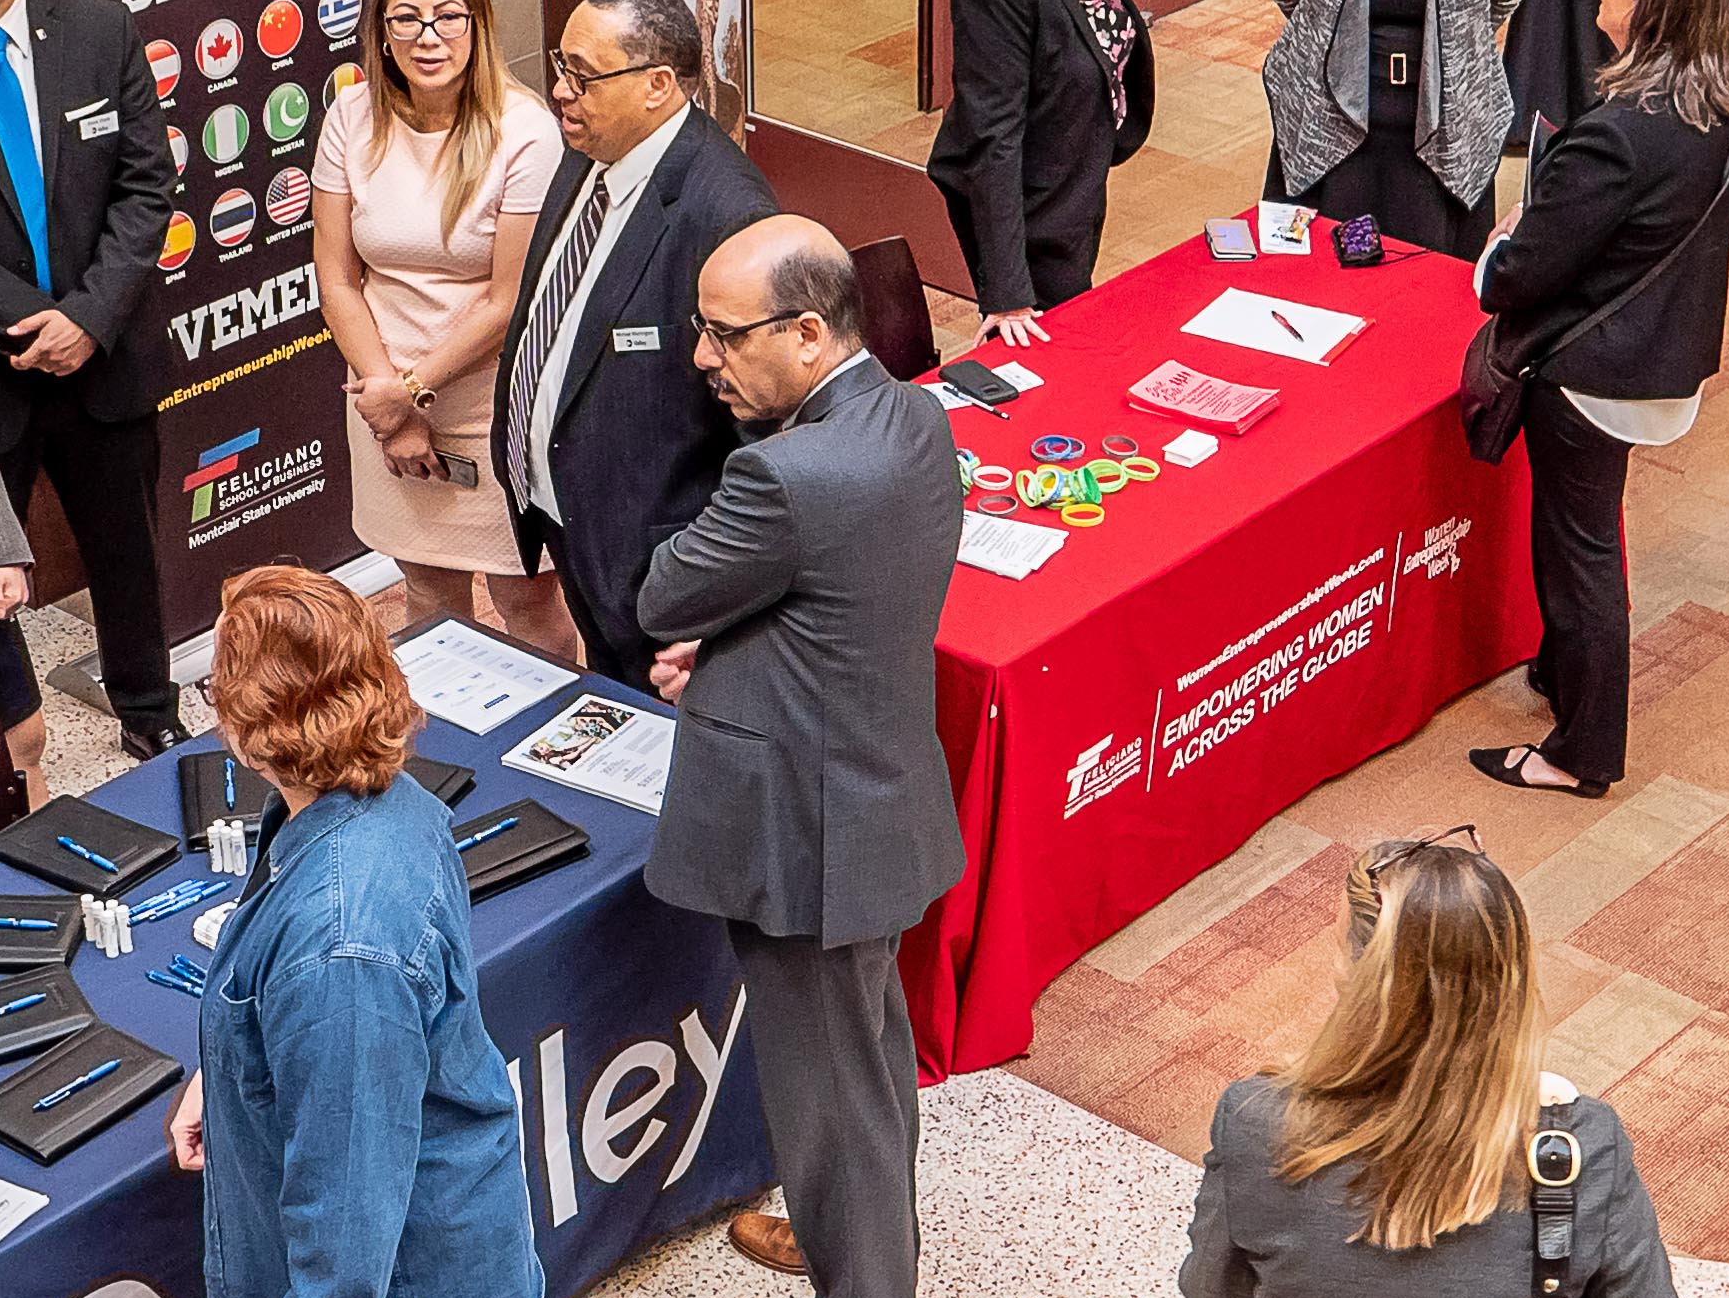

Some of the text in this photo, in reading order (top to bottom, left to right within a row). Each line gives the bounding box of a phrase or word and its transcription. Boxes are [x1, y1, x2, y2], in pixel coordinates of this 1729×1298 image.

[328, 35, 357, 51] GREECE
[271, 56, 294, 71] CHINA
[206, 76, 239, 94] CANADA
[271, 138, 306, 157] PAKISTAN
[214, 161, 245, 178] NIGERIA
[218, 243, 254, 263] THAILAND
[265, 225, 291, 245] UNITED
[165, 269, 187, 285] SPAIN
[167, 262, 322, 362] VEME
[217, 439, 323, 499] FELICIANO
[217, 456, 323, 512] SCHOOL of BUSINESS
[188, 477, 326, 550] Montclair State University
[1424, 516, 1456, 548] Women
[1176, 547, 1385, 693] WomenEntrepreneurshipWeek.com
[1162, 582, 1385, 749] EMPOWERING WOMEN
[1167, 699, 1256, 778] ACROSS
[1259, 672, 1298, 715] THE
[1301, 620, 1374, 685] GLOBE
[1084, 736, 1142, 783] FELICIANO
[505, 983, 748, 1243] ley
